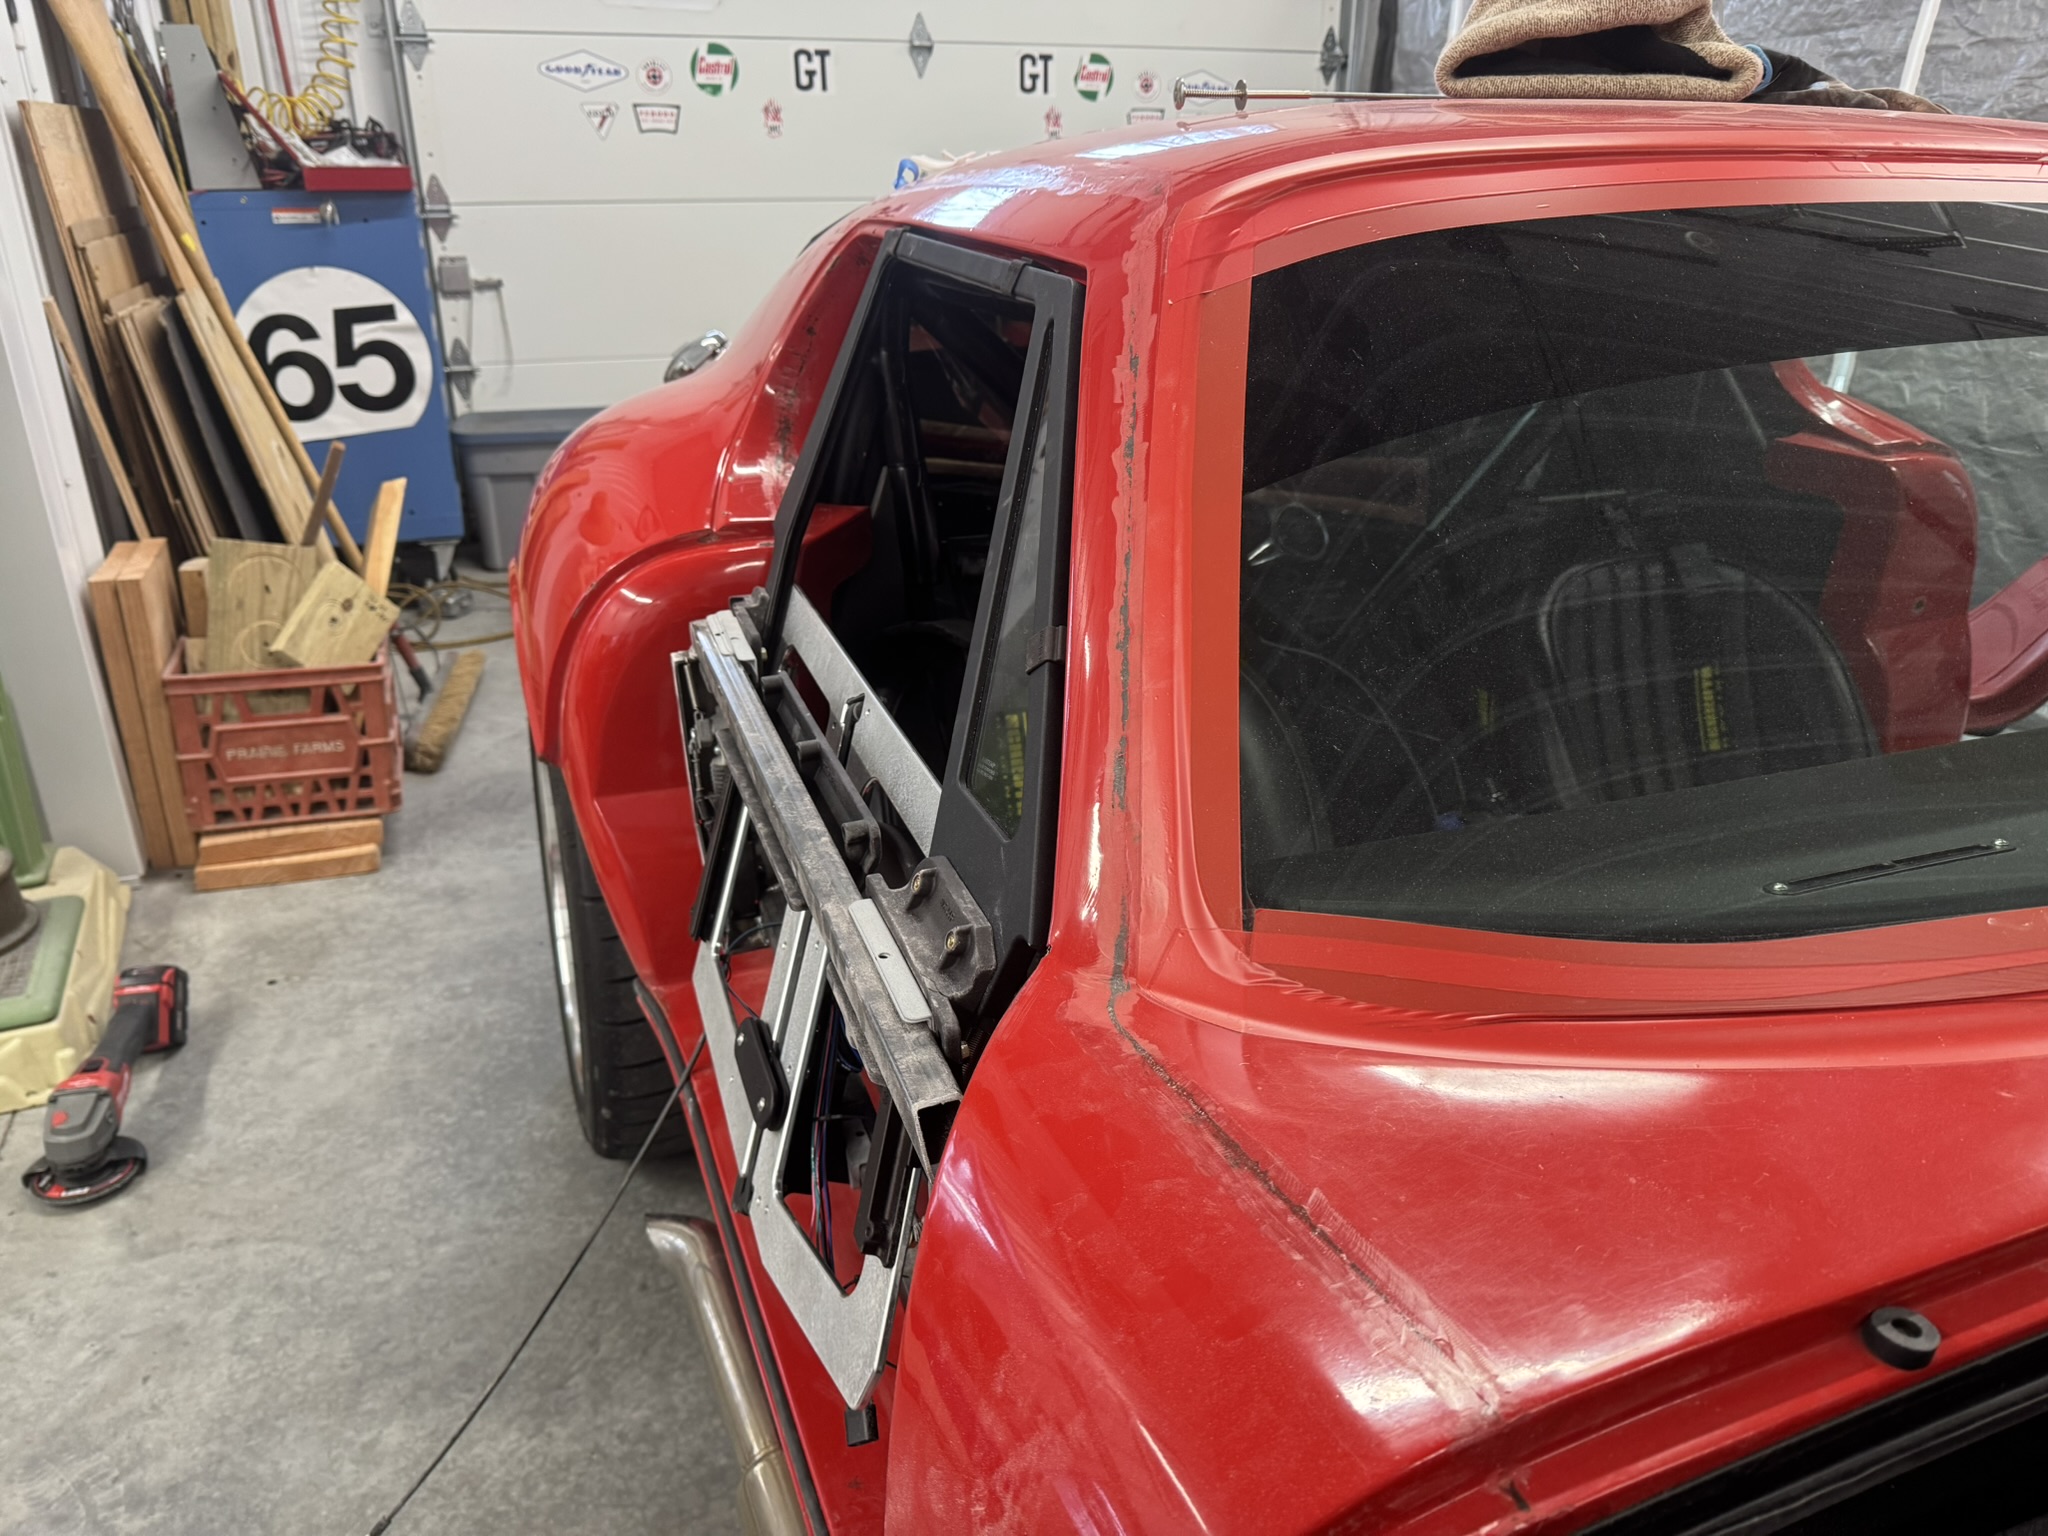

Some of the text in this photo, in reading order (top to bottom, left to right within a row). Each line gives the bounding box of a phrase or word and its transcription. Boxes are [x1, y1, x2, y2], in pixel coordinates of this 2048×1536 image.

[697, 55, 735, 75] Castrol
[793, 48, 831, 92] GT
[1020, 53, 1054, 94] GT
[1080, 64, 1111, 83] Castrol
[247, 304, 417, 423] 65
[225, 739, 346, 762] PRAIRIE FARMS
